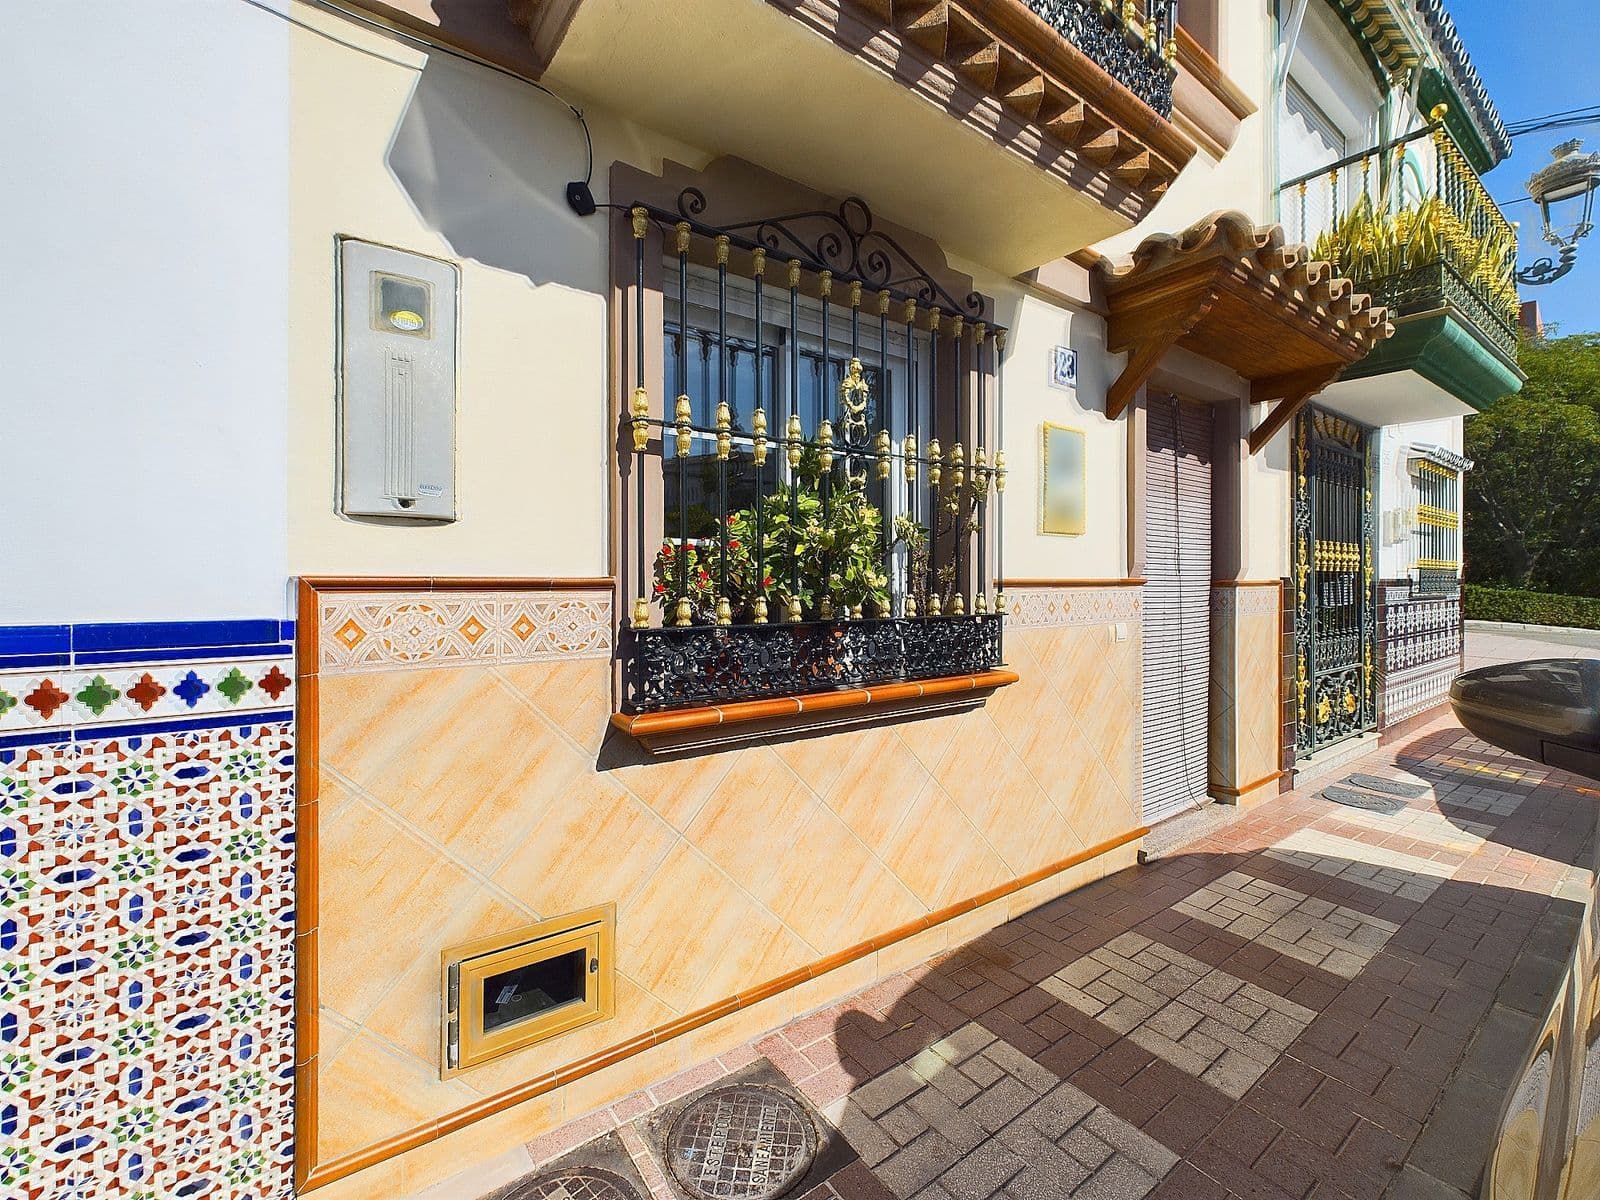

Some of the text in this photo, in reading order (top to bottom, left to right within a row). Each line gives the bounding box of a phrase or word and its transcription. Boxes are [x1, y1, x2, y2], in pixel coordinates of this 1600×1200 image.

[1060, 351, 1075, 379] 23
[703, 1101, 733, 1177] ESTEPONA
[752, 1105, 777, 1184] SANEAMIENTO
